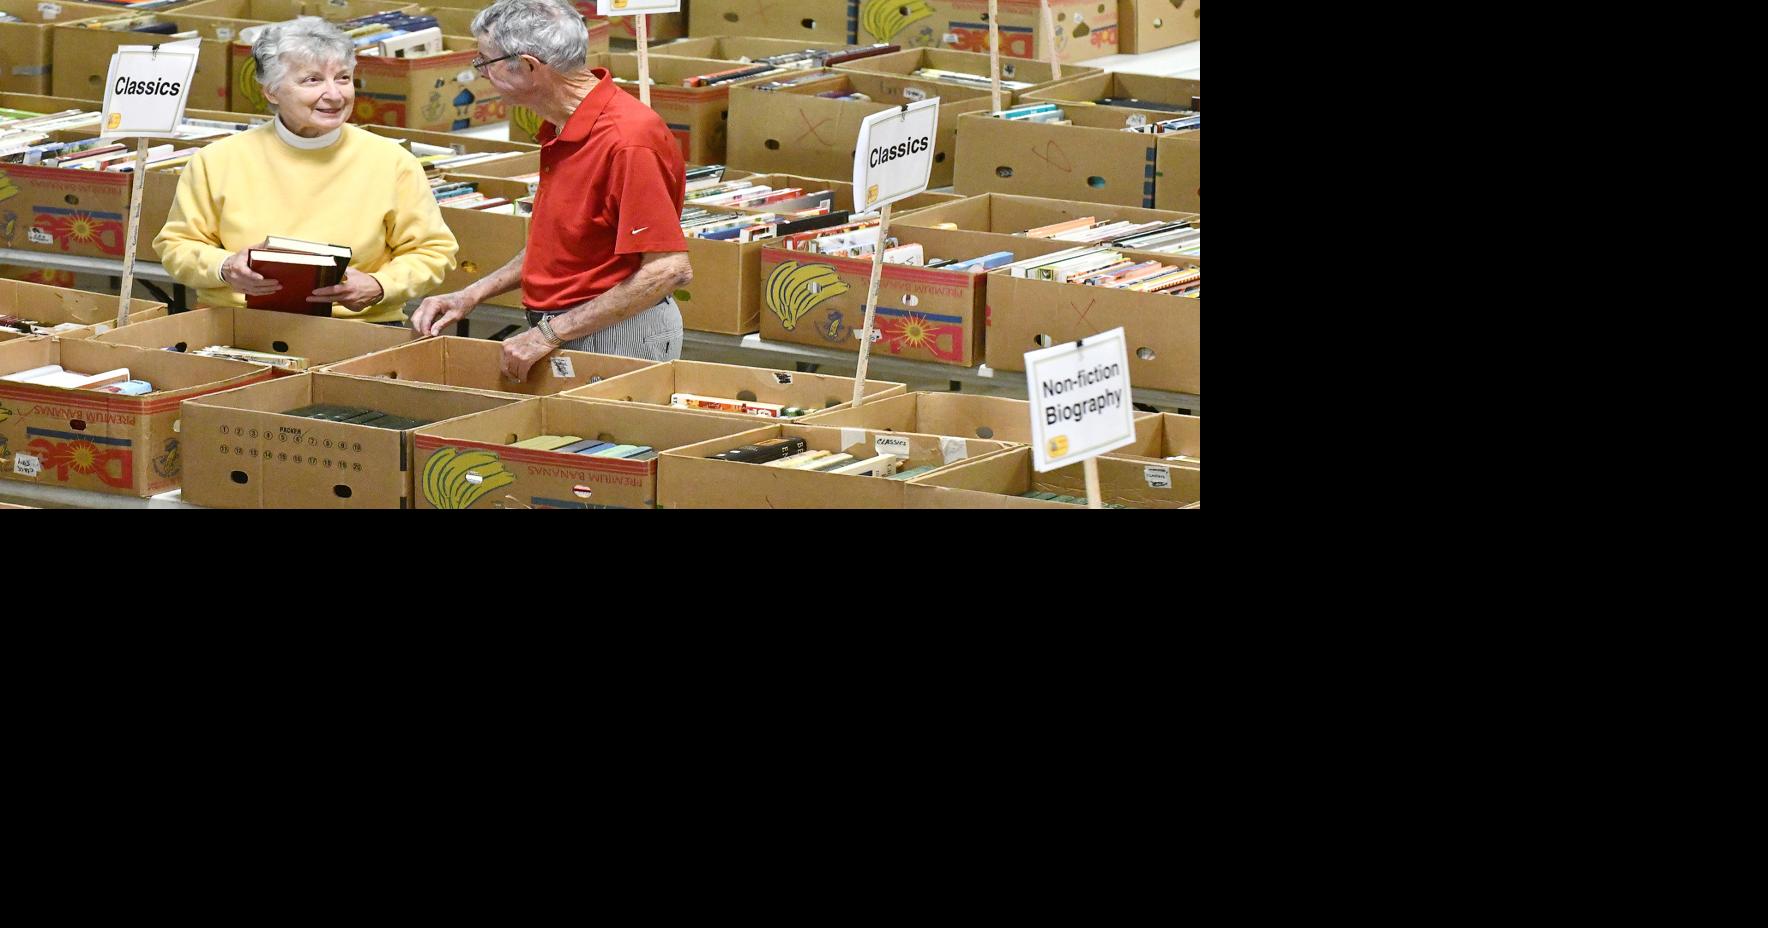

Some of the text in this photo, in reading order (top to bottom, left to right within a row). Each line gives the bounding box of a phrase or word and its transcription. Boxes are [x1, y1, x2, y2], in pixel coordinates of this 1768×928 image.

[115, 77, 180, 96] Classics
[870, 136, 929, 168] Classics
[1042, 363, 1120, 398] Non-fiction
[34, 404, 136, 426] PREMIUM BANANAS
[1045, 389, 1122, 425] Biography
[279, 427, 302, 435] PACKER
[27, 438, 133, 489] Dole
[528, 466, 642, 487] PREMIUM BANANAS
